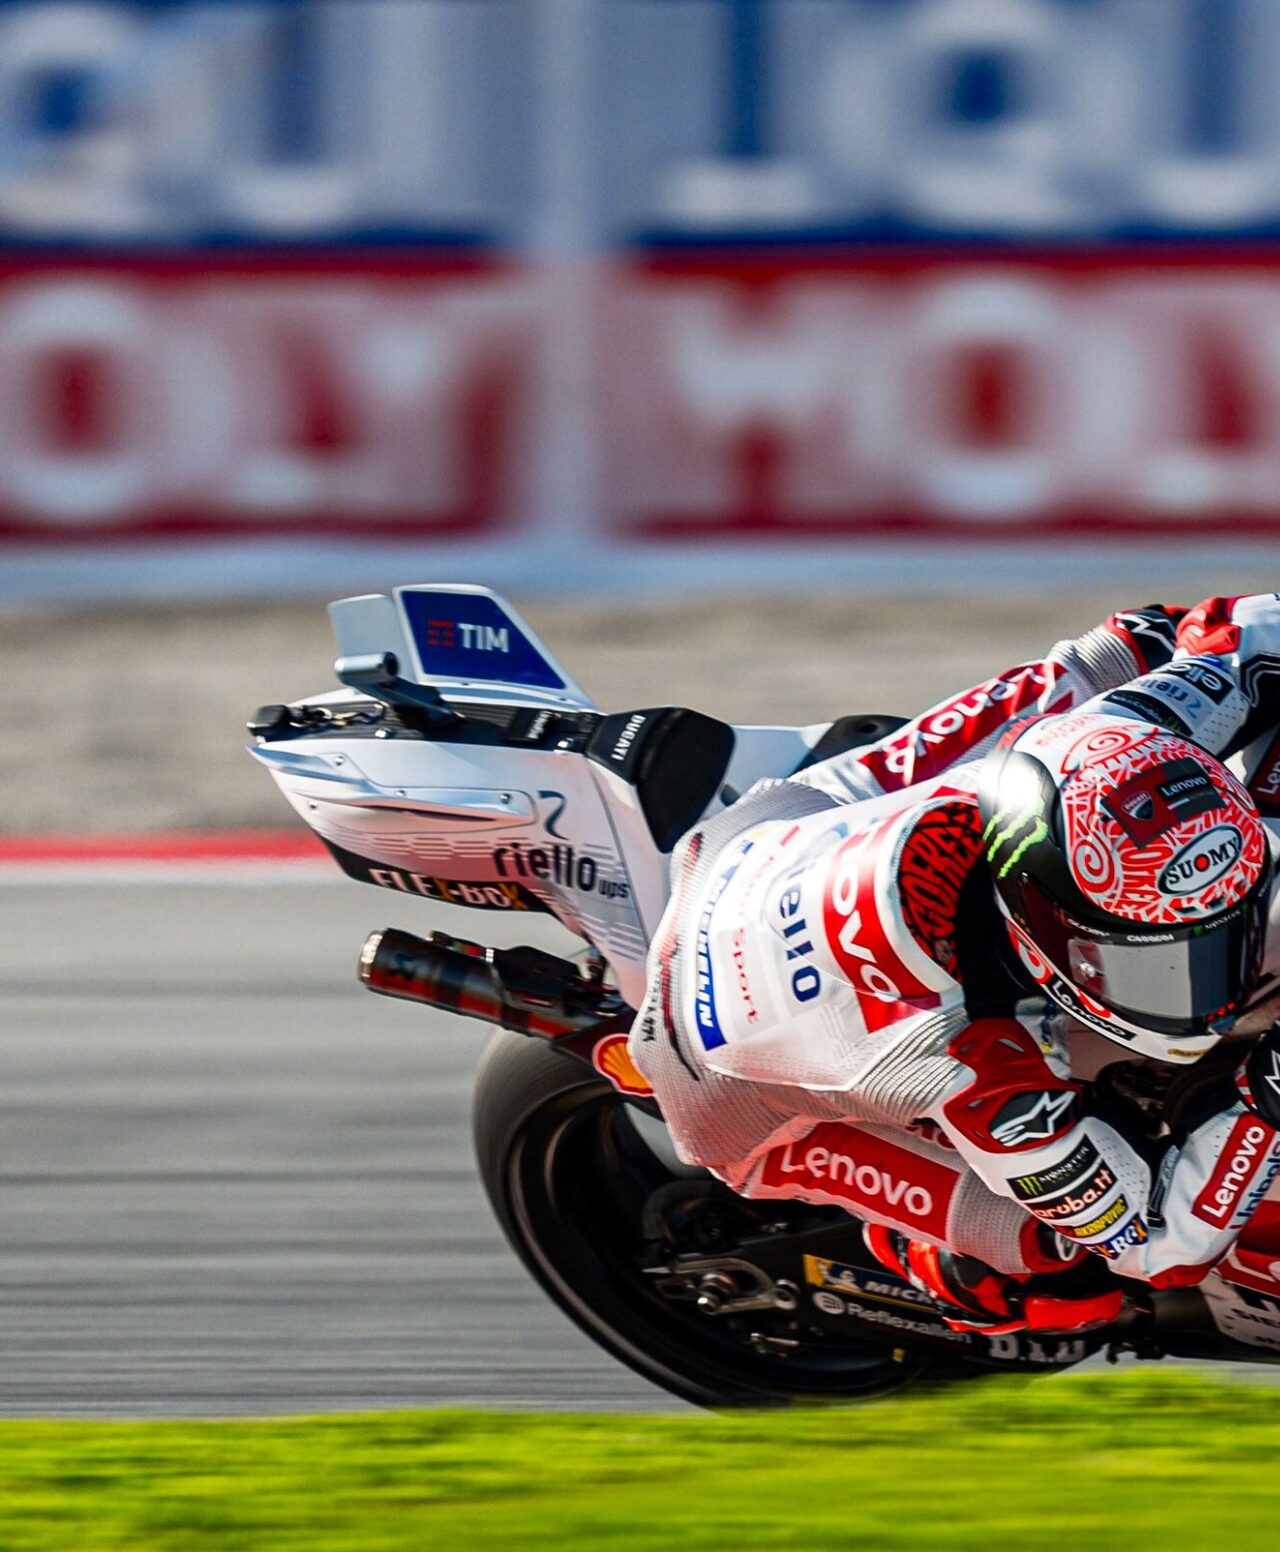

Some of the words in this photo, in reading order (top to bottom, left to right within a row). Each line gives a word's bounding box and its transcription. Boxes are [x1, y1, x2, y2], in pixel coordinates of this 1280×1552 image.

[458, 622, 509, 653] TIM
[611, 714, 646, 761] DUCATI
[1161, 776, 1207, 797] Lenovo
[493, 842, 596, 891] riello
[599, 879, 630, 900] ups
[1165, 837, 1240, 885] SUOMY
[778, 868, 822, 1003] ello
[781, 1143, 934, 1217] Lenovo
[1034, 1168, 1113, 1219] aruba.it
[1201, 1125, 1265, 1219] Lenovo
[848, 1302, 973, 1345] Reflexallen
